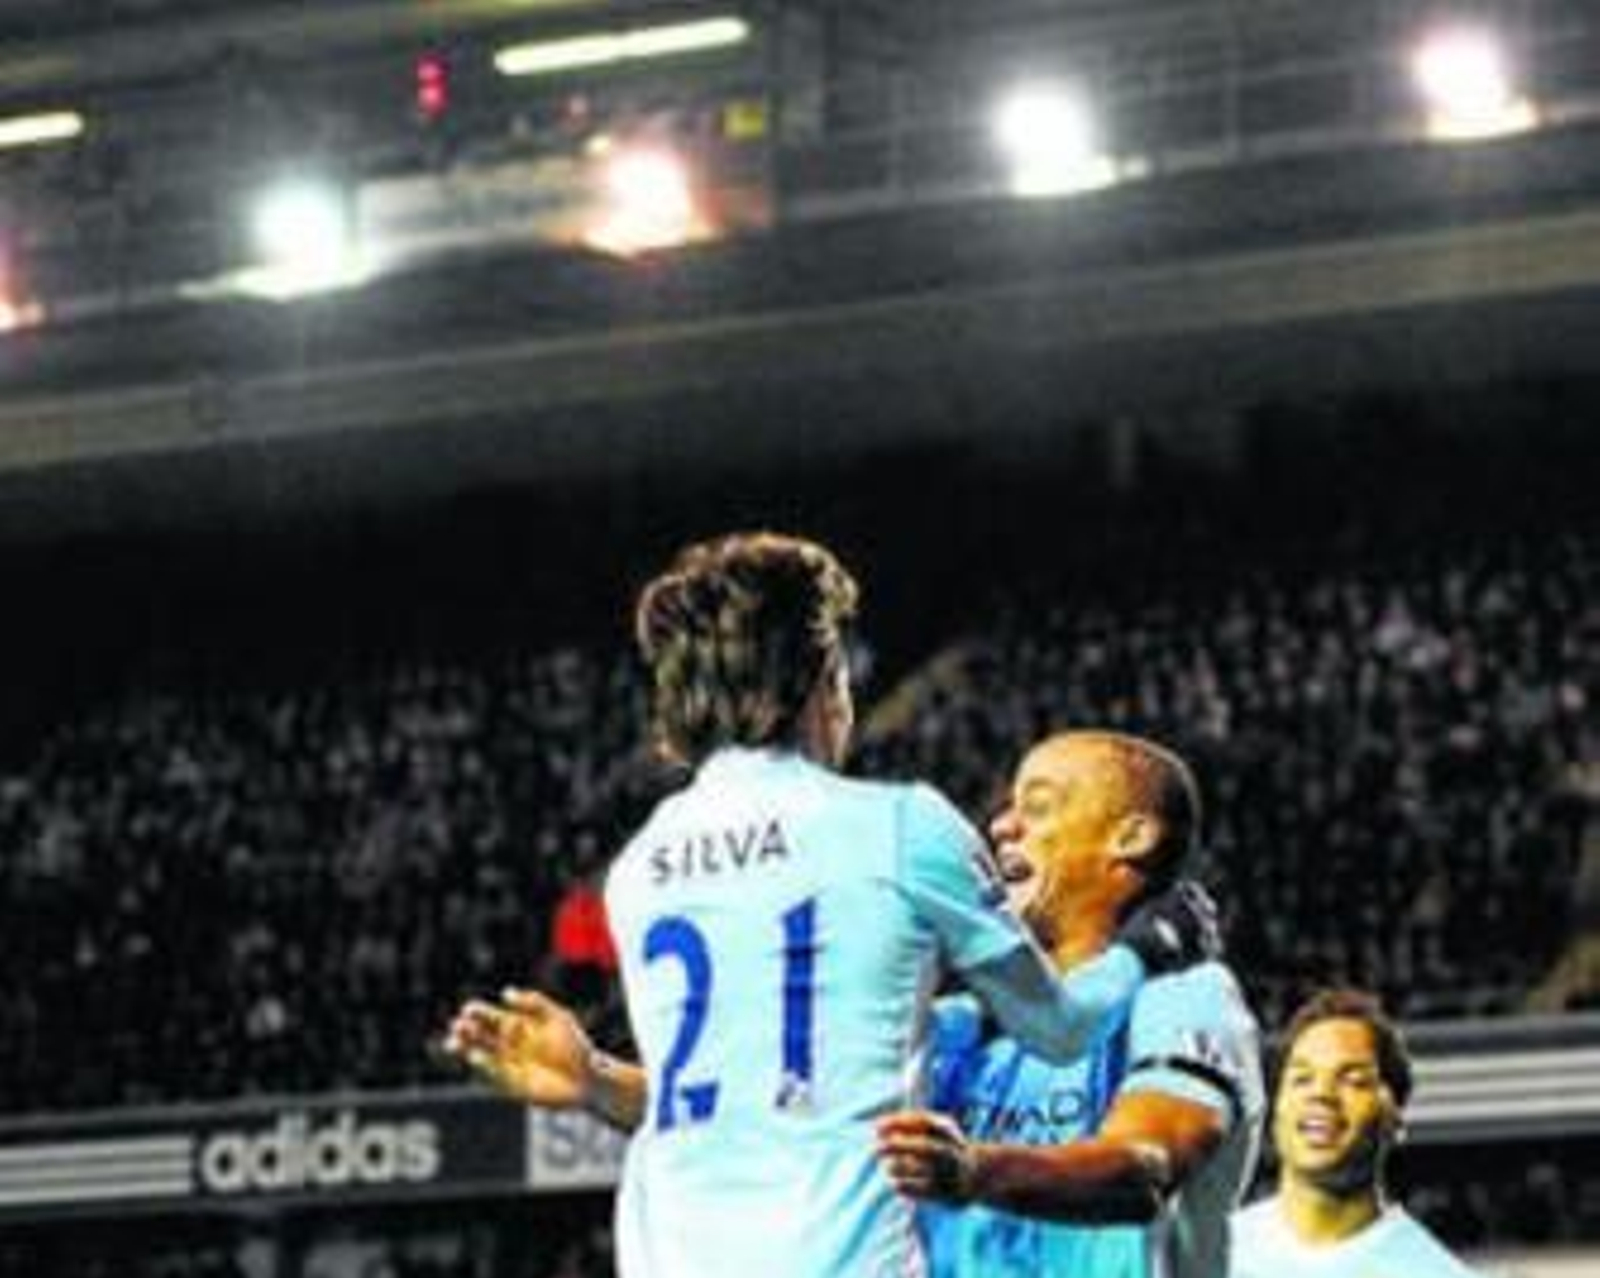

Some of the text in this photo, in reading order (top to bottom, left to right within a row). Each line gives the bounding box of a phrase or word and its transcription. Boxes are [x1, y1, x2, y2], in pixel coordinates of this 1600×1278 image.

[649, 819, 789, 883] SILVA
[642, 897, 817, 1132] 21
[202, 1112, 441, 1191] adidas
